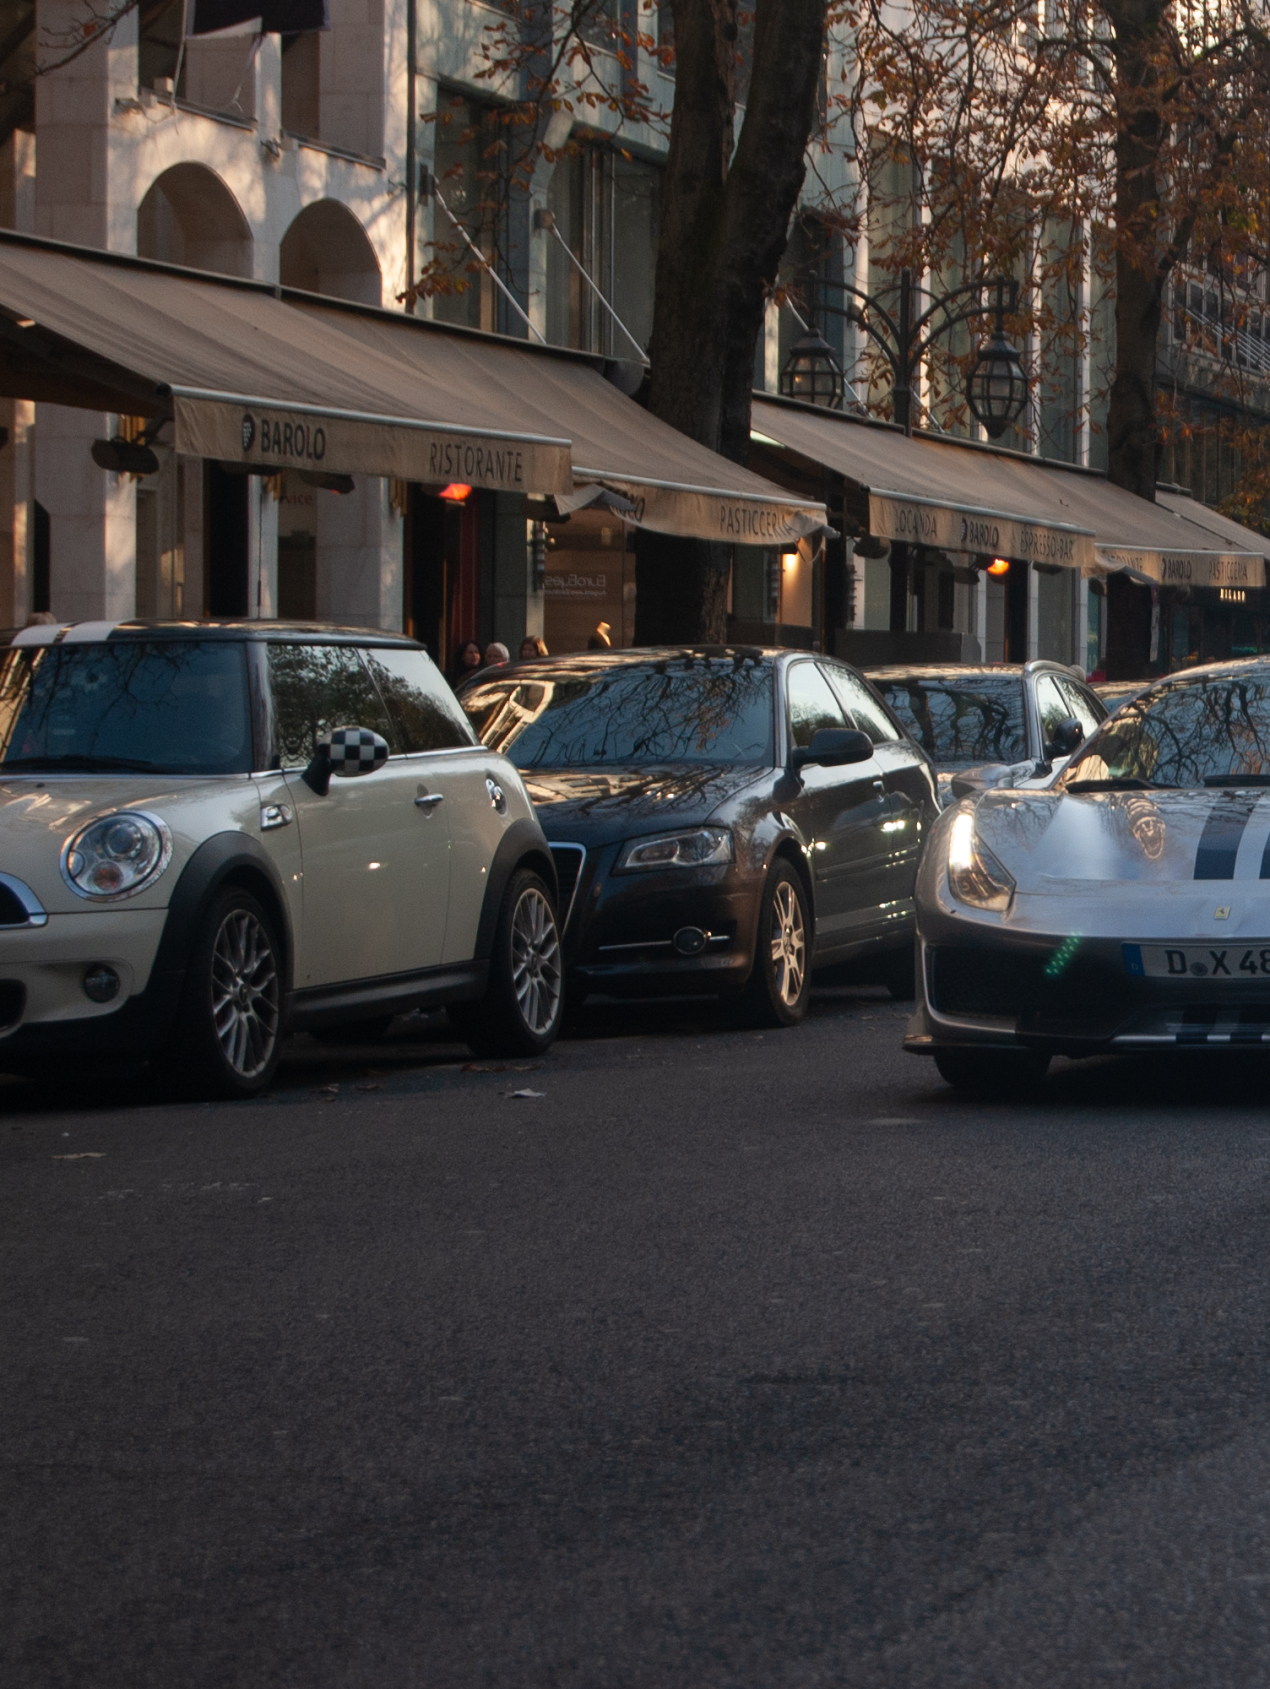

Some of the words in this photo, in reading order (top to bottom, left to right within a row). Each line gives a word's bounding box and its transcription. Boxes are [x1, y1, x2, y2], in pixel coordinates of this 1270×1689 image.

[260, 419, 326, 461] BAROLO
[430, 442, 522, 482] RISTORANTE
[720, 505, 799, 537] PASTICCERIA
[894, 509, 937, 537] LOCANDA
[969, 521, 999, 548] BAROLO
[1165, 950, 1187, 975] D
[1209, 950, 1231, 975] X
